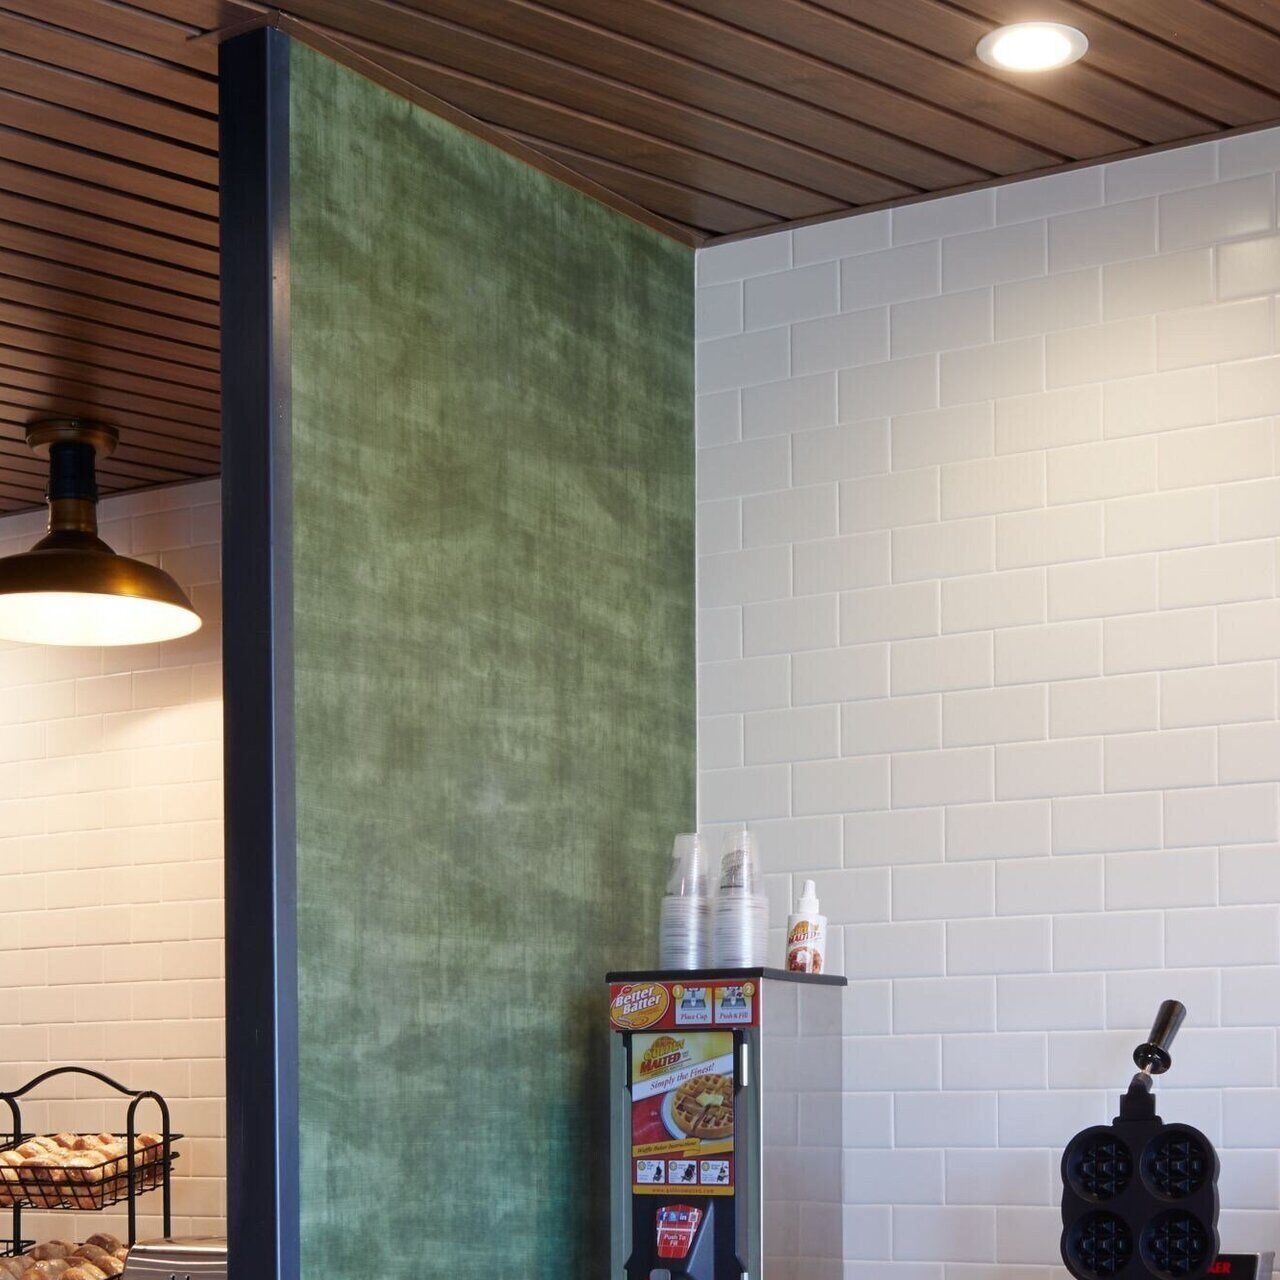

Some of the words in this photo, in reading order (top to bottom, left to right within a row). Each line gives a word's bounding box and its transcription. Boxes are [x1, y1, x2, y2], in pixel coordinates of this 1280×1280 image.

[616, 985, 654, 1007] Better
[623, 994, 662, 1015] Batter
[640, 1052, 681, 1074] MALTED
[650, 1075, 675, 1090] Simply
[677, 1071, 688, 1081] the
[690, 1061, 715, 1078] Finest!
[664, 1233, 678, 1241] Push
